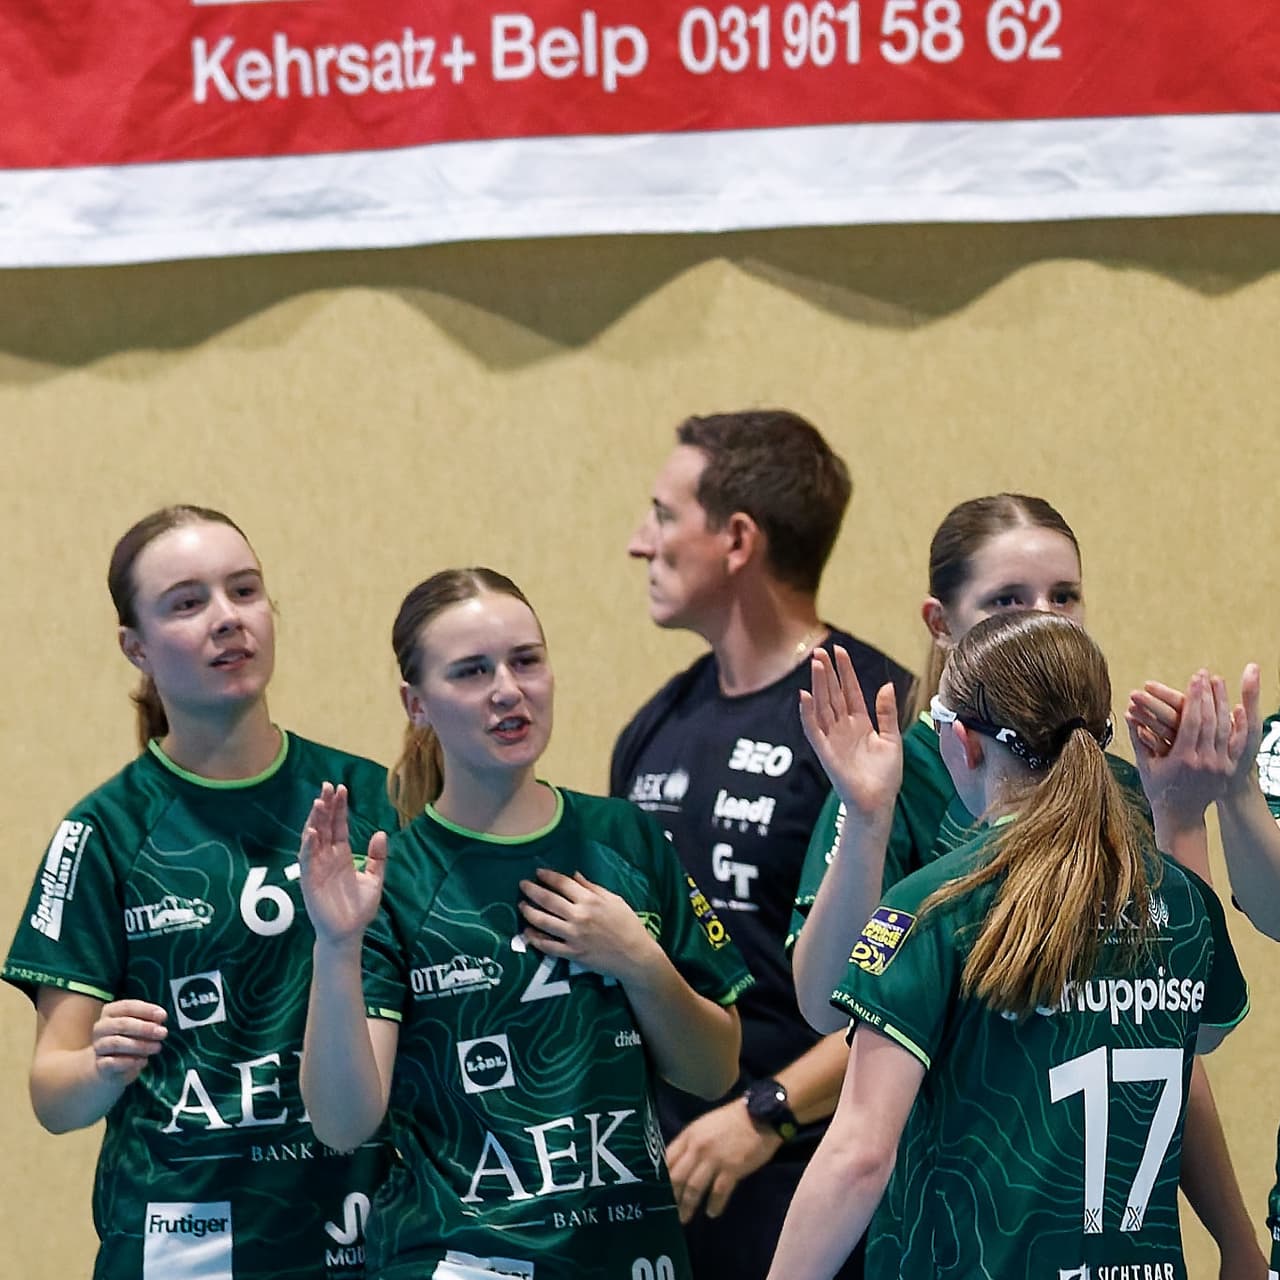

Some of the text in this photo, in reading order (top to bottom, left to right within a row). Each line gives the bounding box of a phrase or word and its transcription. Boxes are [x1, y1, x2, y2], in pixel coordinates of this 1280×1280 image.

[491, 8, 649, 90] Belp
[879, 0, 965, 62] 58
[986, 0, 1062, 60] 62
[240, 862, 300, 936] 6
[161, 1050, 312, 1134] AE
[251, 1142, 315, 1161] BANK
[460, 1109, 643, 1204] AEK
[1048, 1044, 1185, 1235] 17
[150, 1214, 229, 1238] Frutiger
[607, 1204, 643, 1223] 1826
